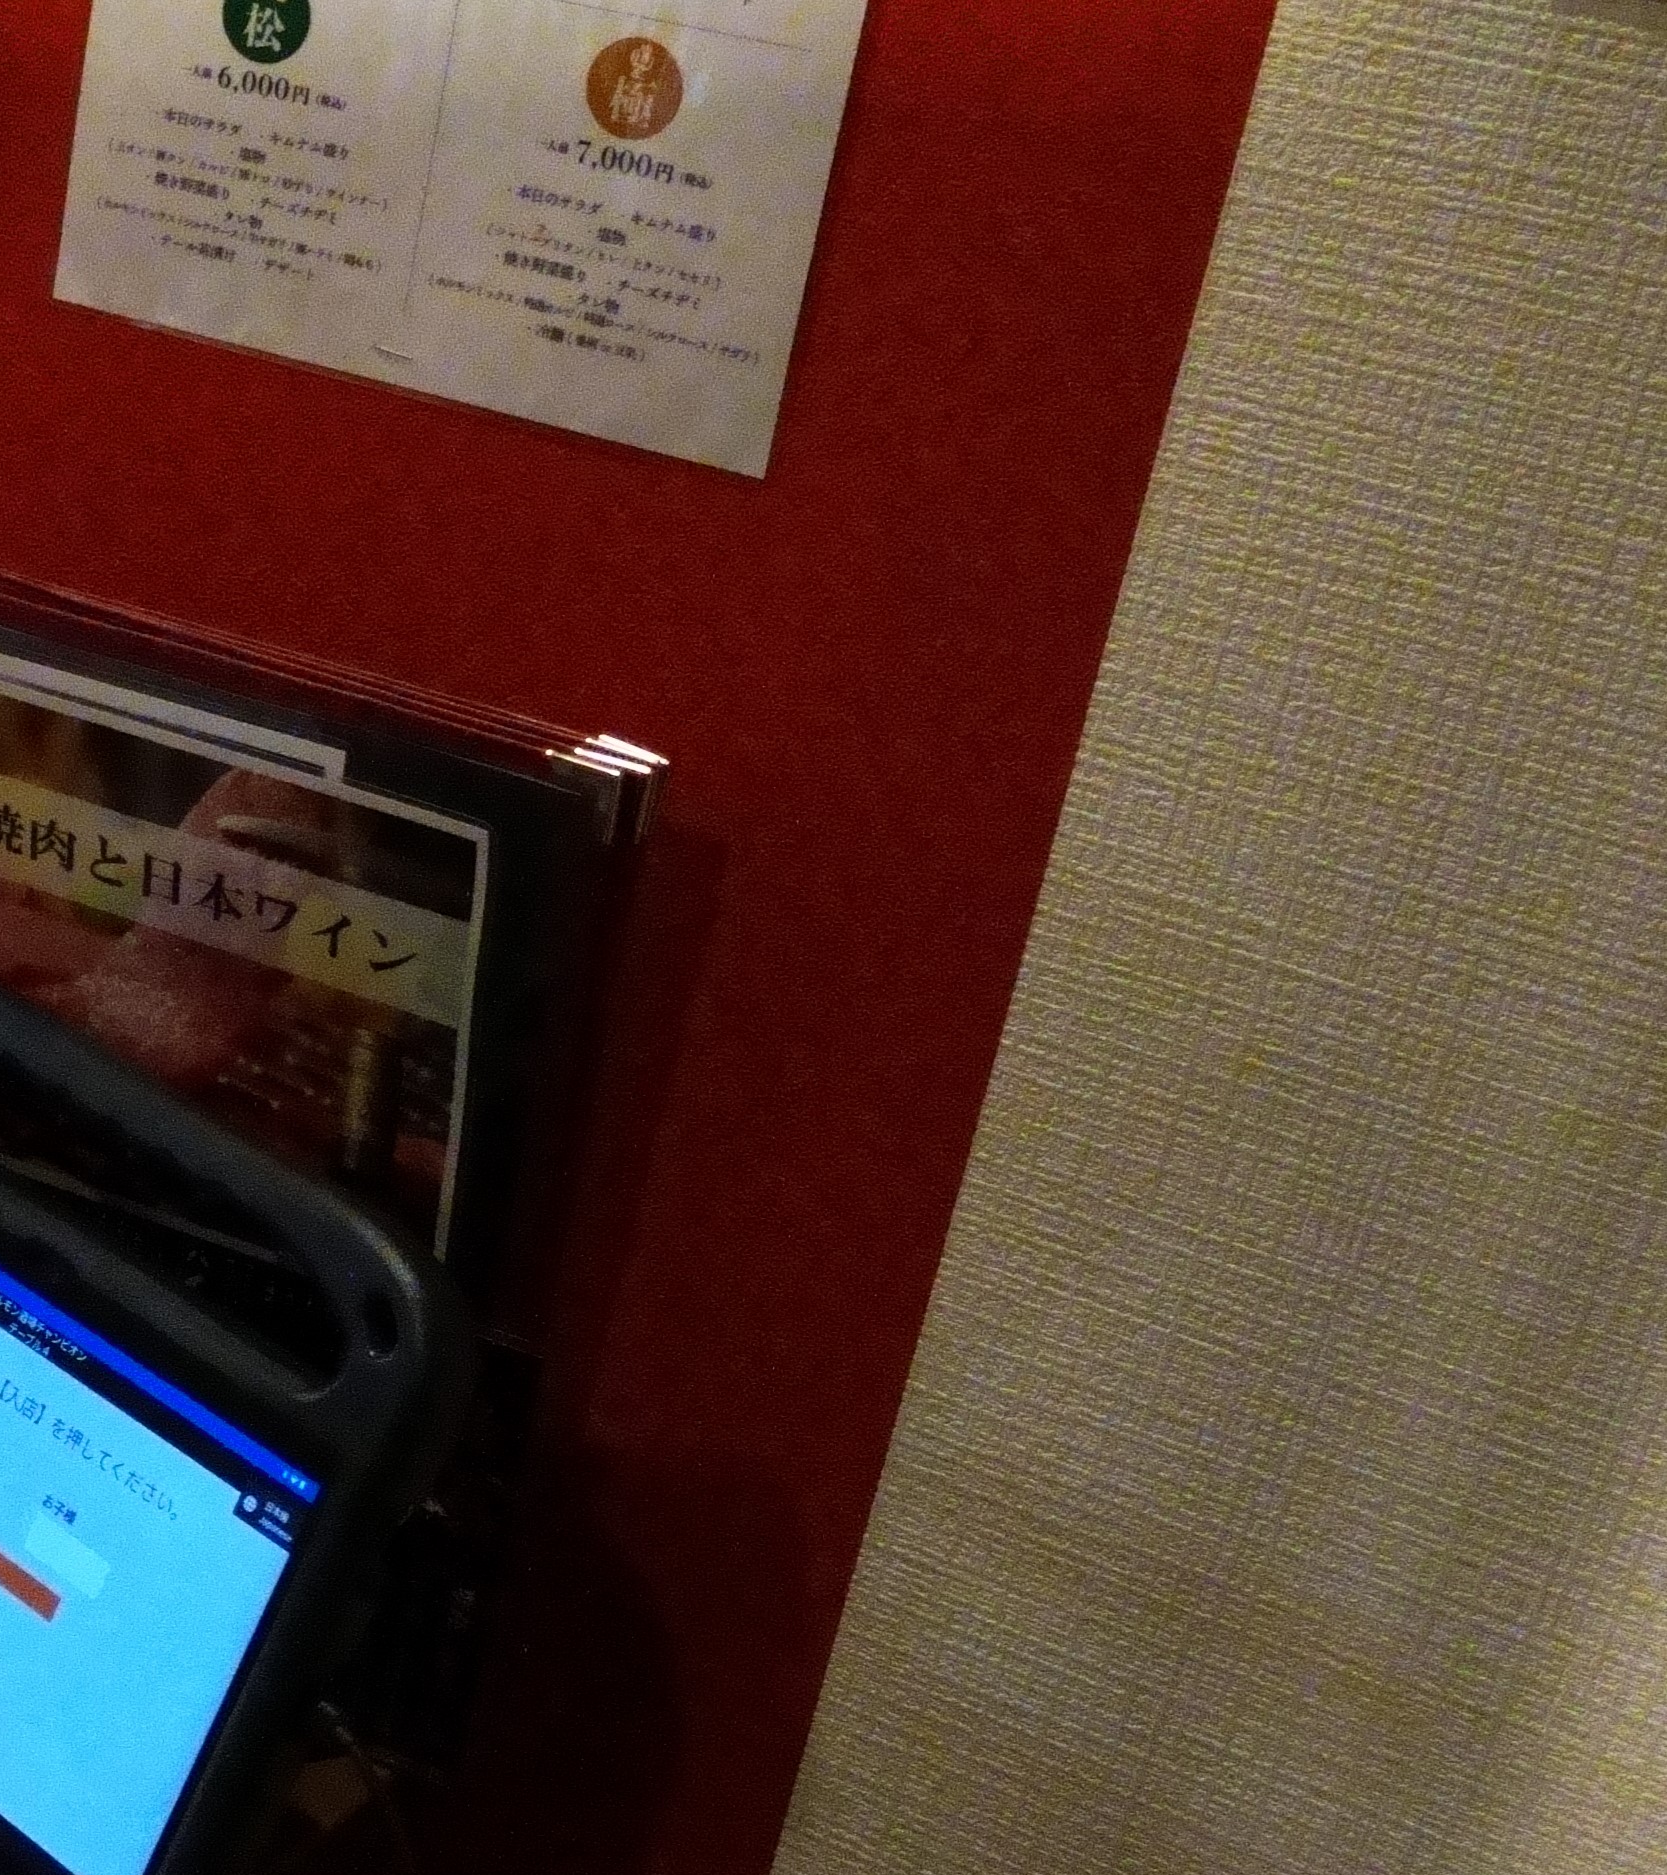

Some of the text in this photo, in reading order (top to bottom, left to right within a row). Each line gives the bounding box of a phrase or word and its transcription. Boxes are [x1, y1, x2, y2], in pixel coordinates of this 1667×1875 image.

[577, 138, 676, 184] 7,000円
[41, 1492, 78, 1527] お子様
